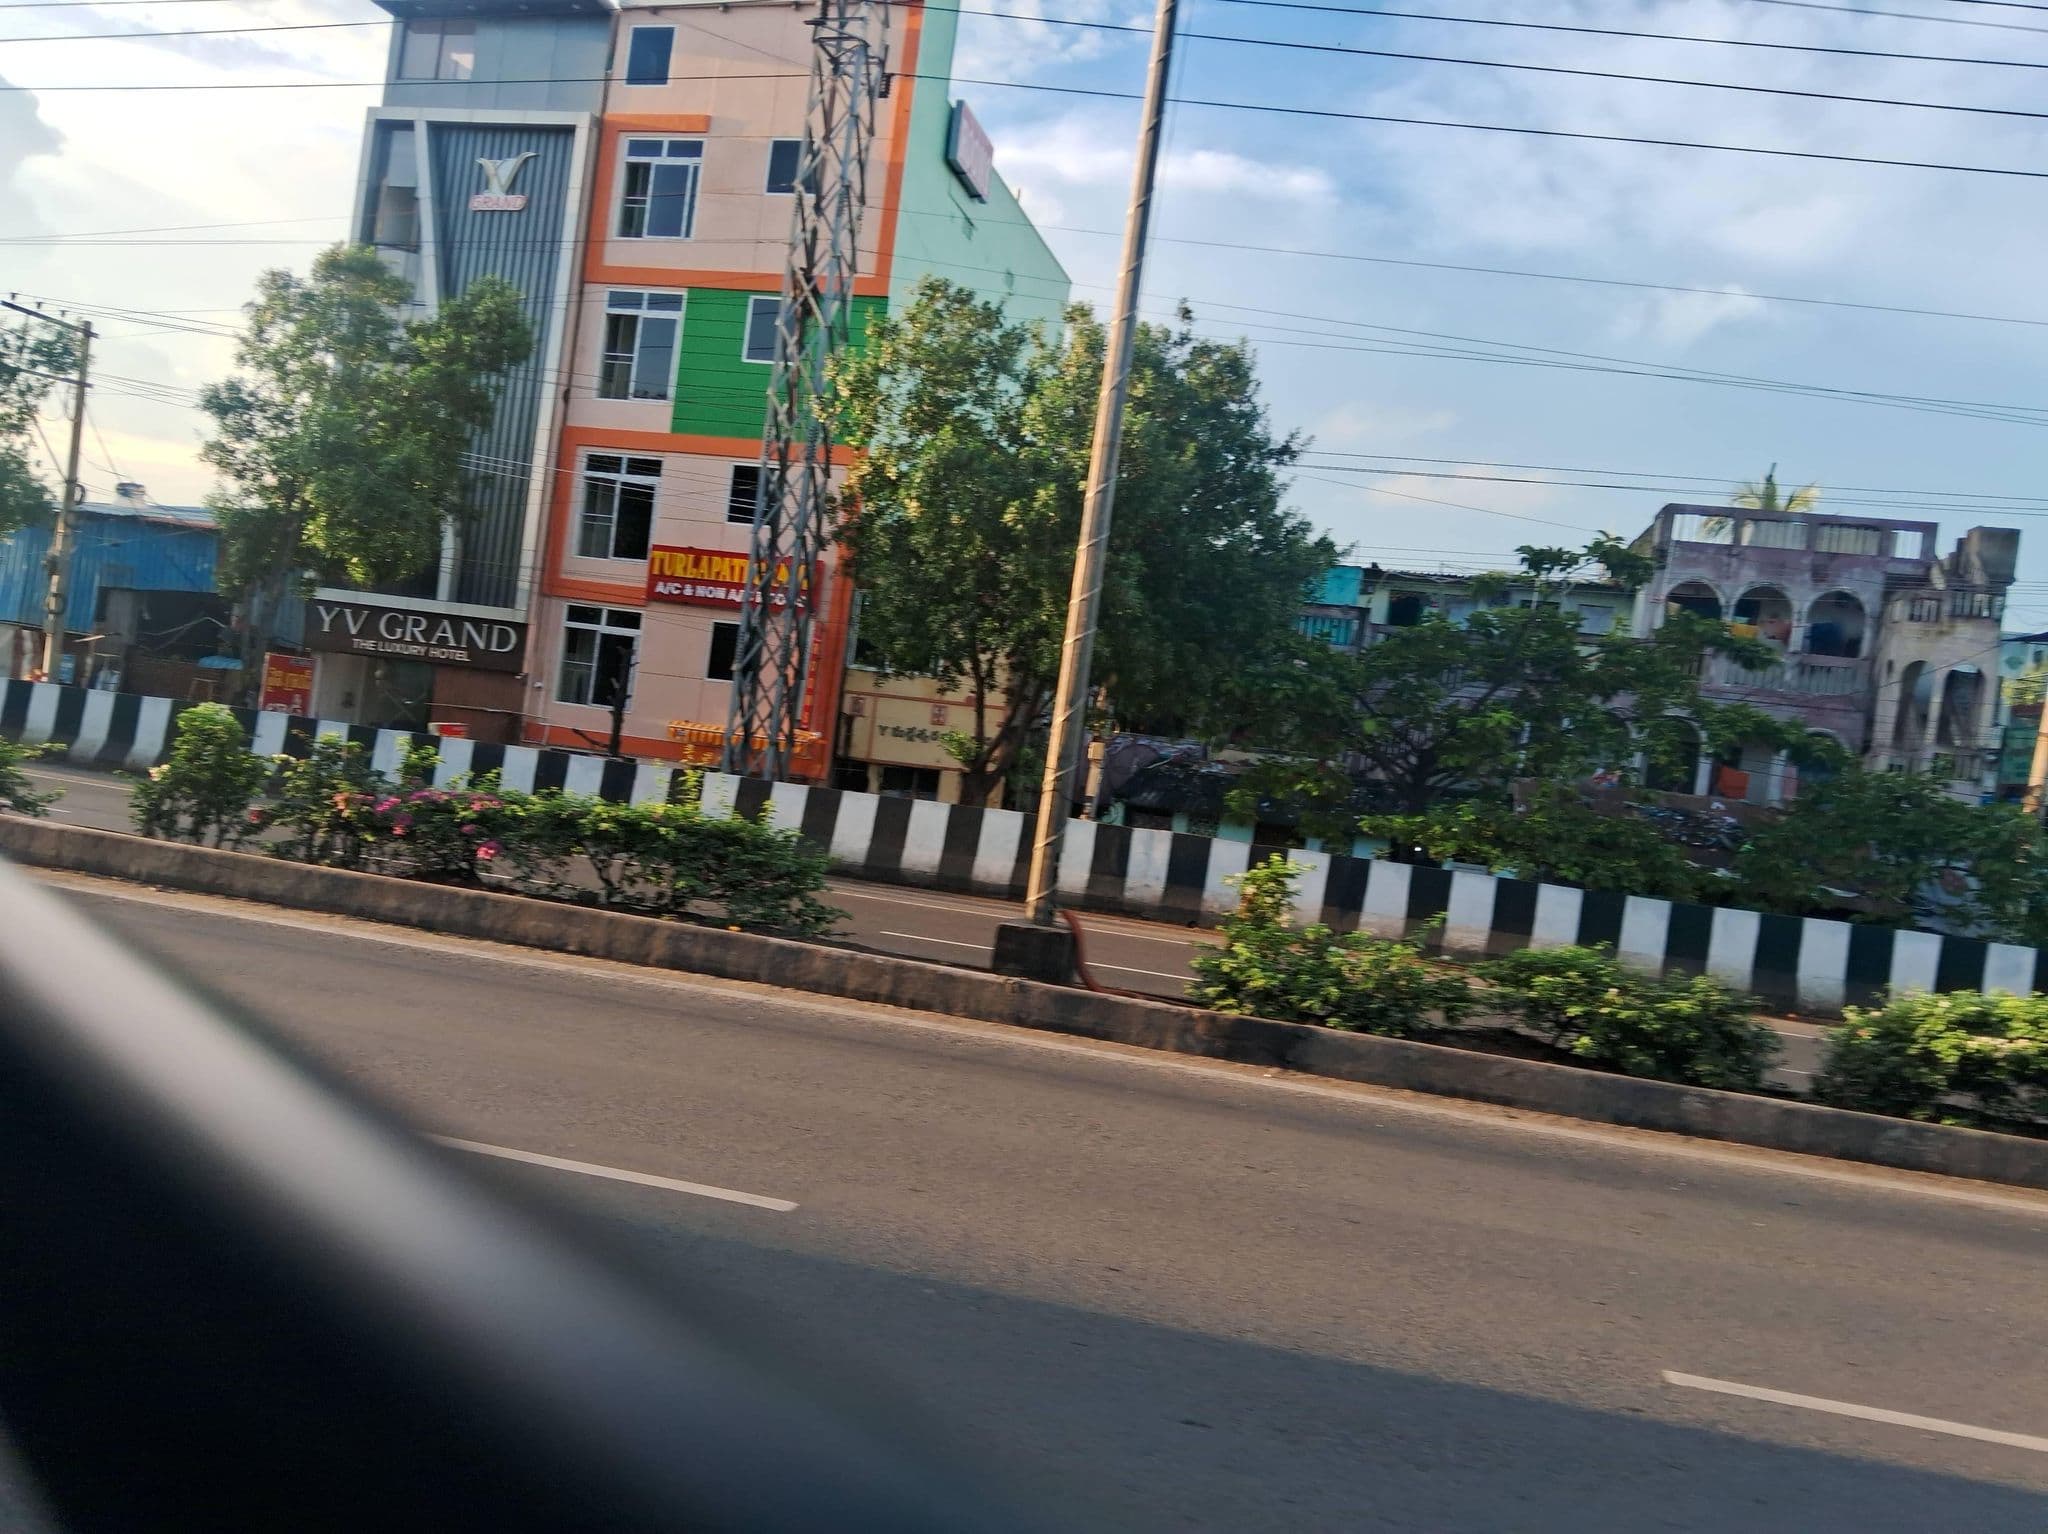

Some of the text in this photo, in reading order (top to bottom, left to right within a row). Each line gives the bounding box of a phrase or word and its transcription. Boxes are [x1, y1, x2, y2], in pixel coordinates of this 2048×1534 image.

[655, 581, 682, 596] A/C
[683, 584, 695, 597] &
[695, 585, 727, 599] NON
[378, 612, 518, 653] GRAND
[352, 637, 377, 651] THE
[428, 646, 472, 662] HOTEL
